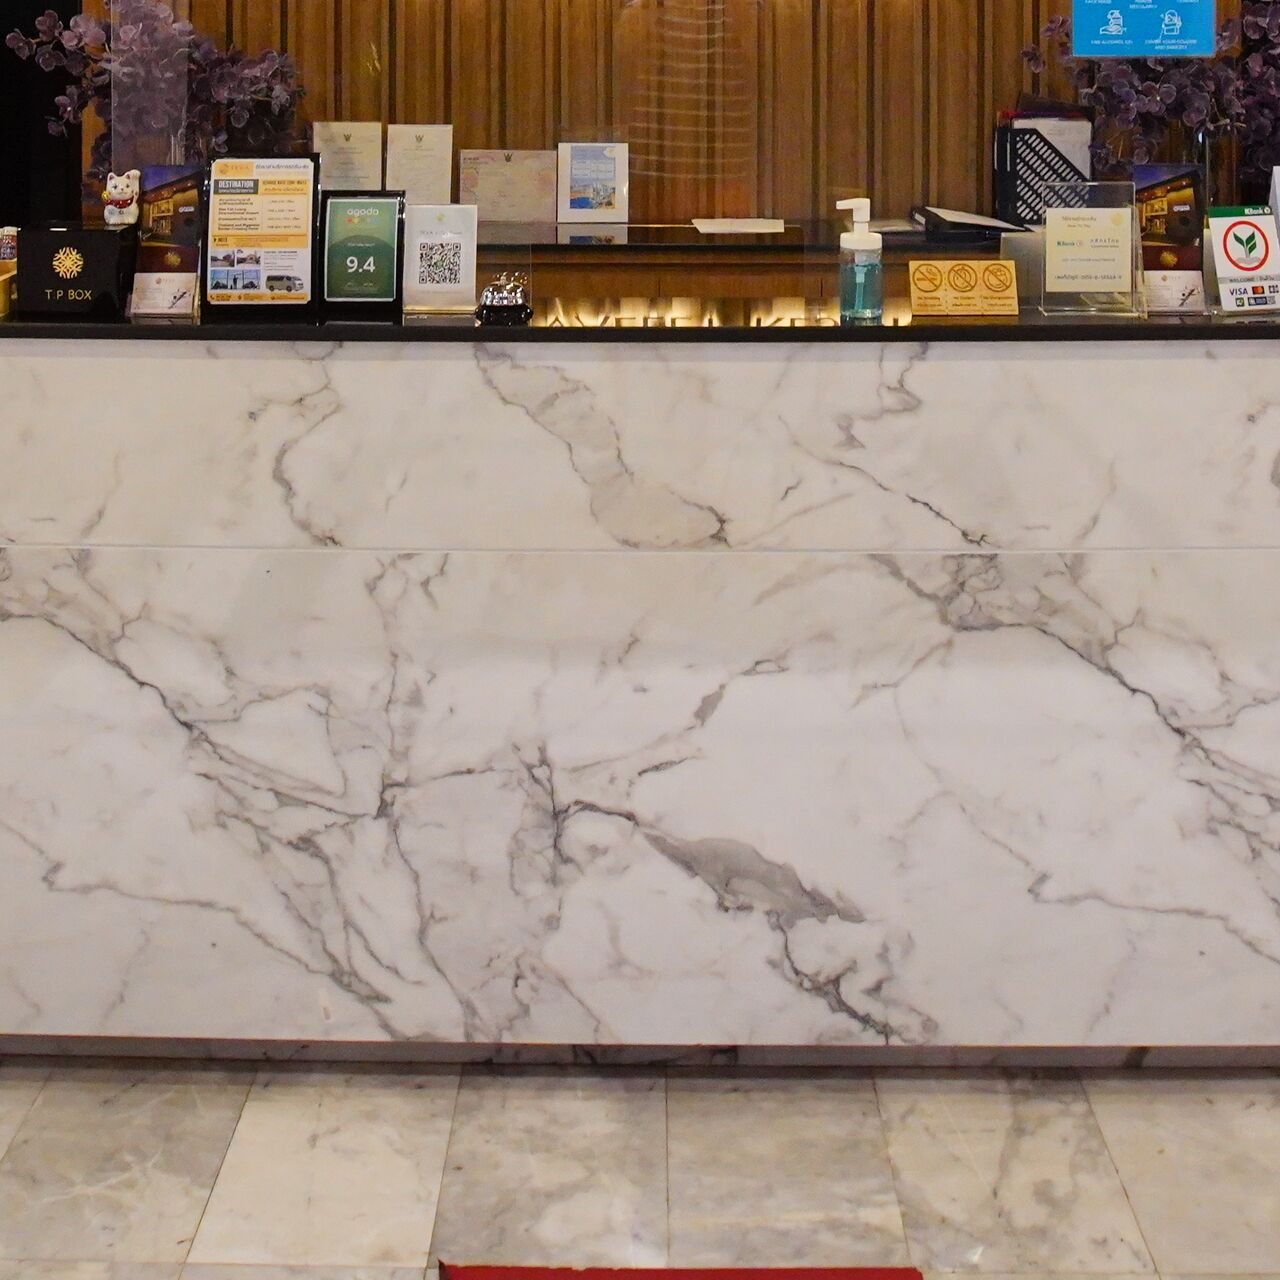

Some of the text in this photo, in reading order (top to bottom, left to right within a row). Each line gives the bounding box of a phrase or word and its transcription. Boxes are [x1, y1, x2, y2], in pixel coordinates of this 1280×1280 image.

[346, 207, 380, 217] agoda
[346, 255, 376, 273] 9.4
[69, 289, 93, 300] BOX
[1229, 287, 1249, 297] VISA
